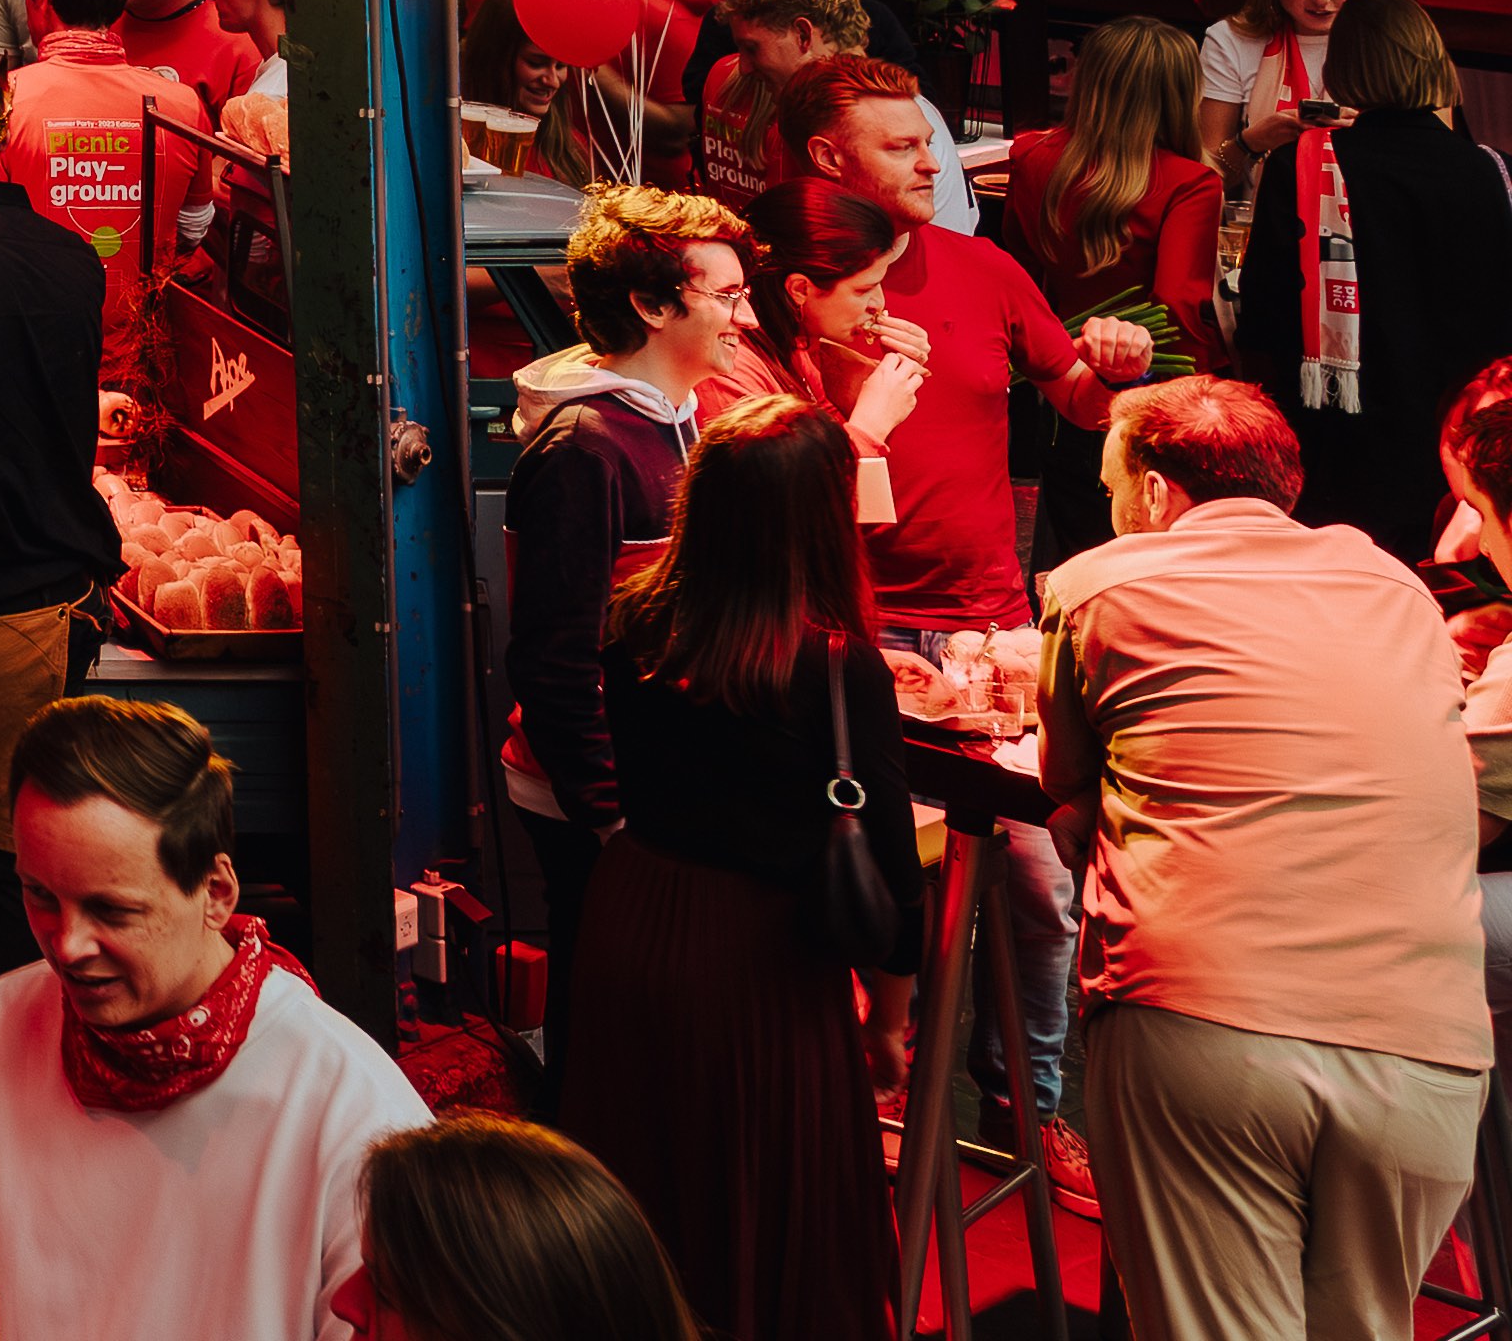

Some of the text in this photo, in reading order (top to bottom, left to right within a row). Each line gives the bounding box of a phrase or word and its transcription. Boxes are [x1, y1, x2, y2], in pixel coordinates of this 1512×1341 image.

[49, 131, 130, 153] Picnic
[50, 180, 142, 206] ground
[1344, 285, 1357, 310] PIC
